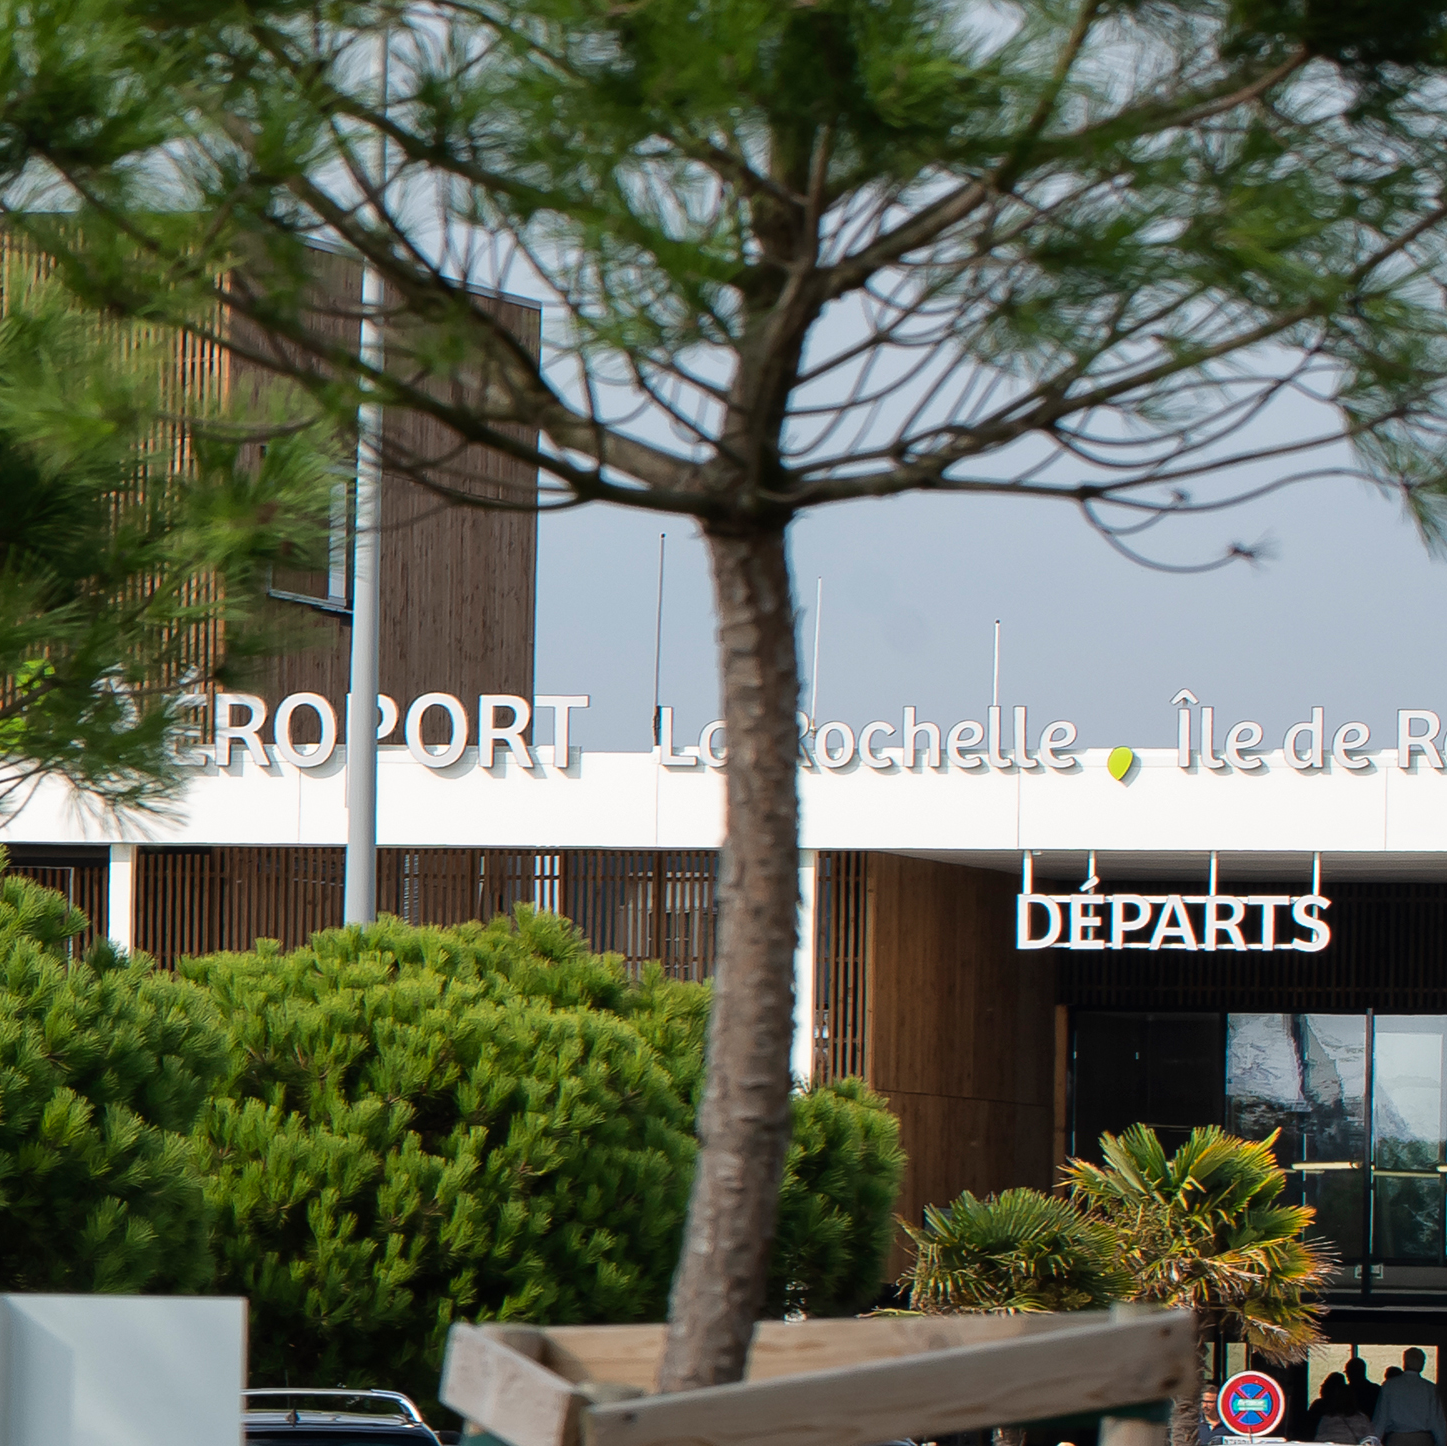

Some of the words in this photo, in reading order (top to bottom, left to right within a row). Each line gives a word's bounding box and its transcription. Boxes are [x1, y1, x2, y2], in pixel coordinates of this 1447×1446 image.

[1170, 688, 1264, 769] Île
[1283, 706, 1371, 769] de
[1397, 708, 1447, 769] R
[1016, 875, 1332, 952] DÉPARTS
